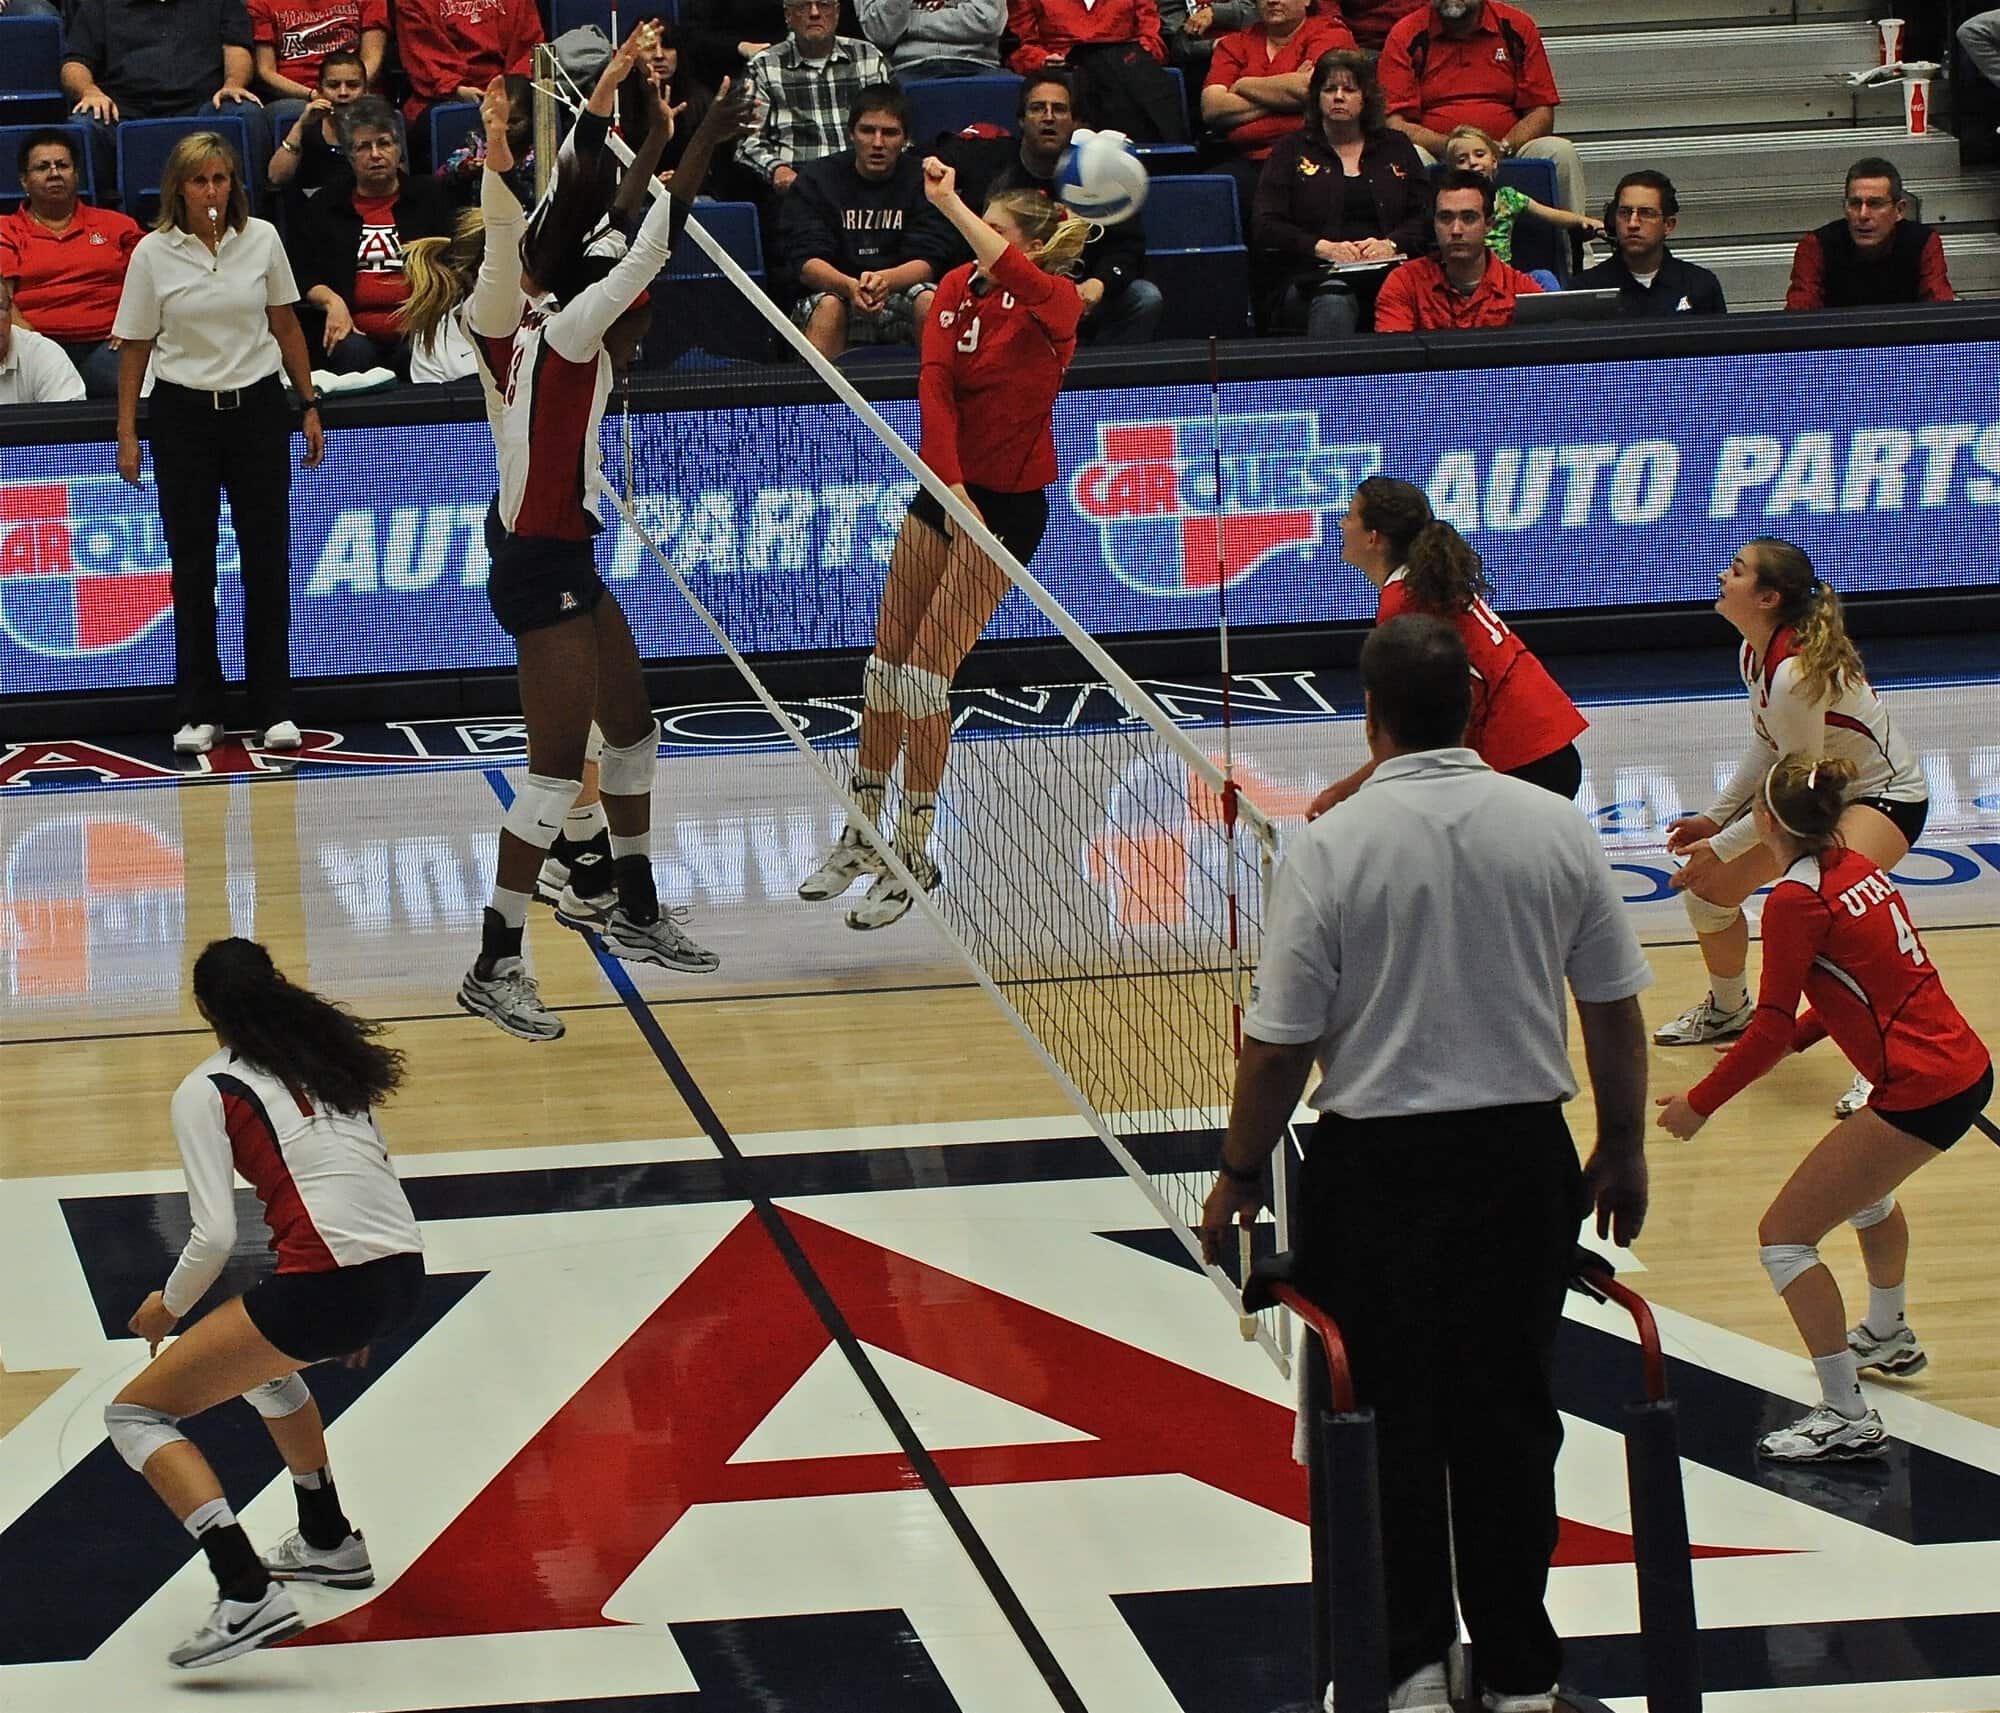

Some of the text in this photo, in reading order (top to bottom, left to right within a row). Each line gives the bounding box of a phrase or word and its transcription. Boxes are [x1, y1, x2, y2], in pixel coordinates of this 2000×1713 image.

[357, 224, 403, 273] A
[1424, 438, 1683, 533] AUTO
[304, 503, 498, 595] AUT
[1889, 902, 1924, 966] 4
